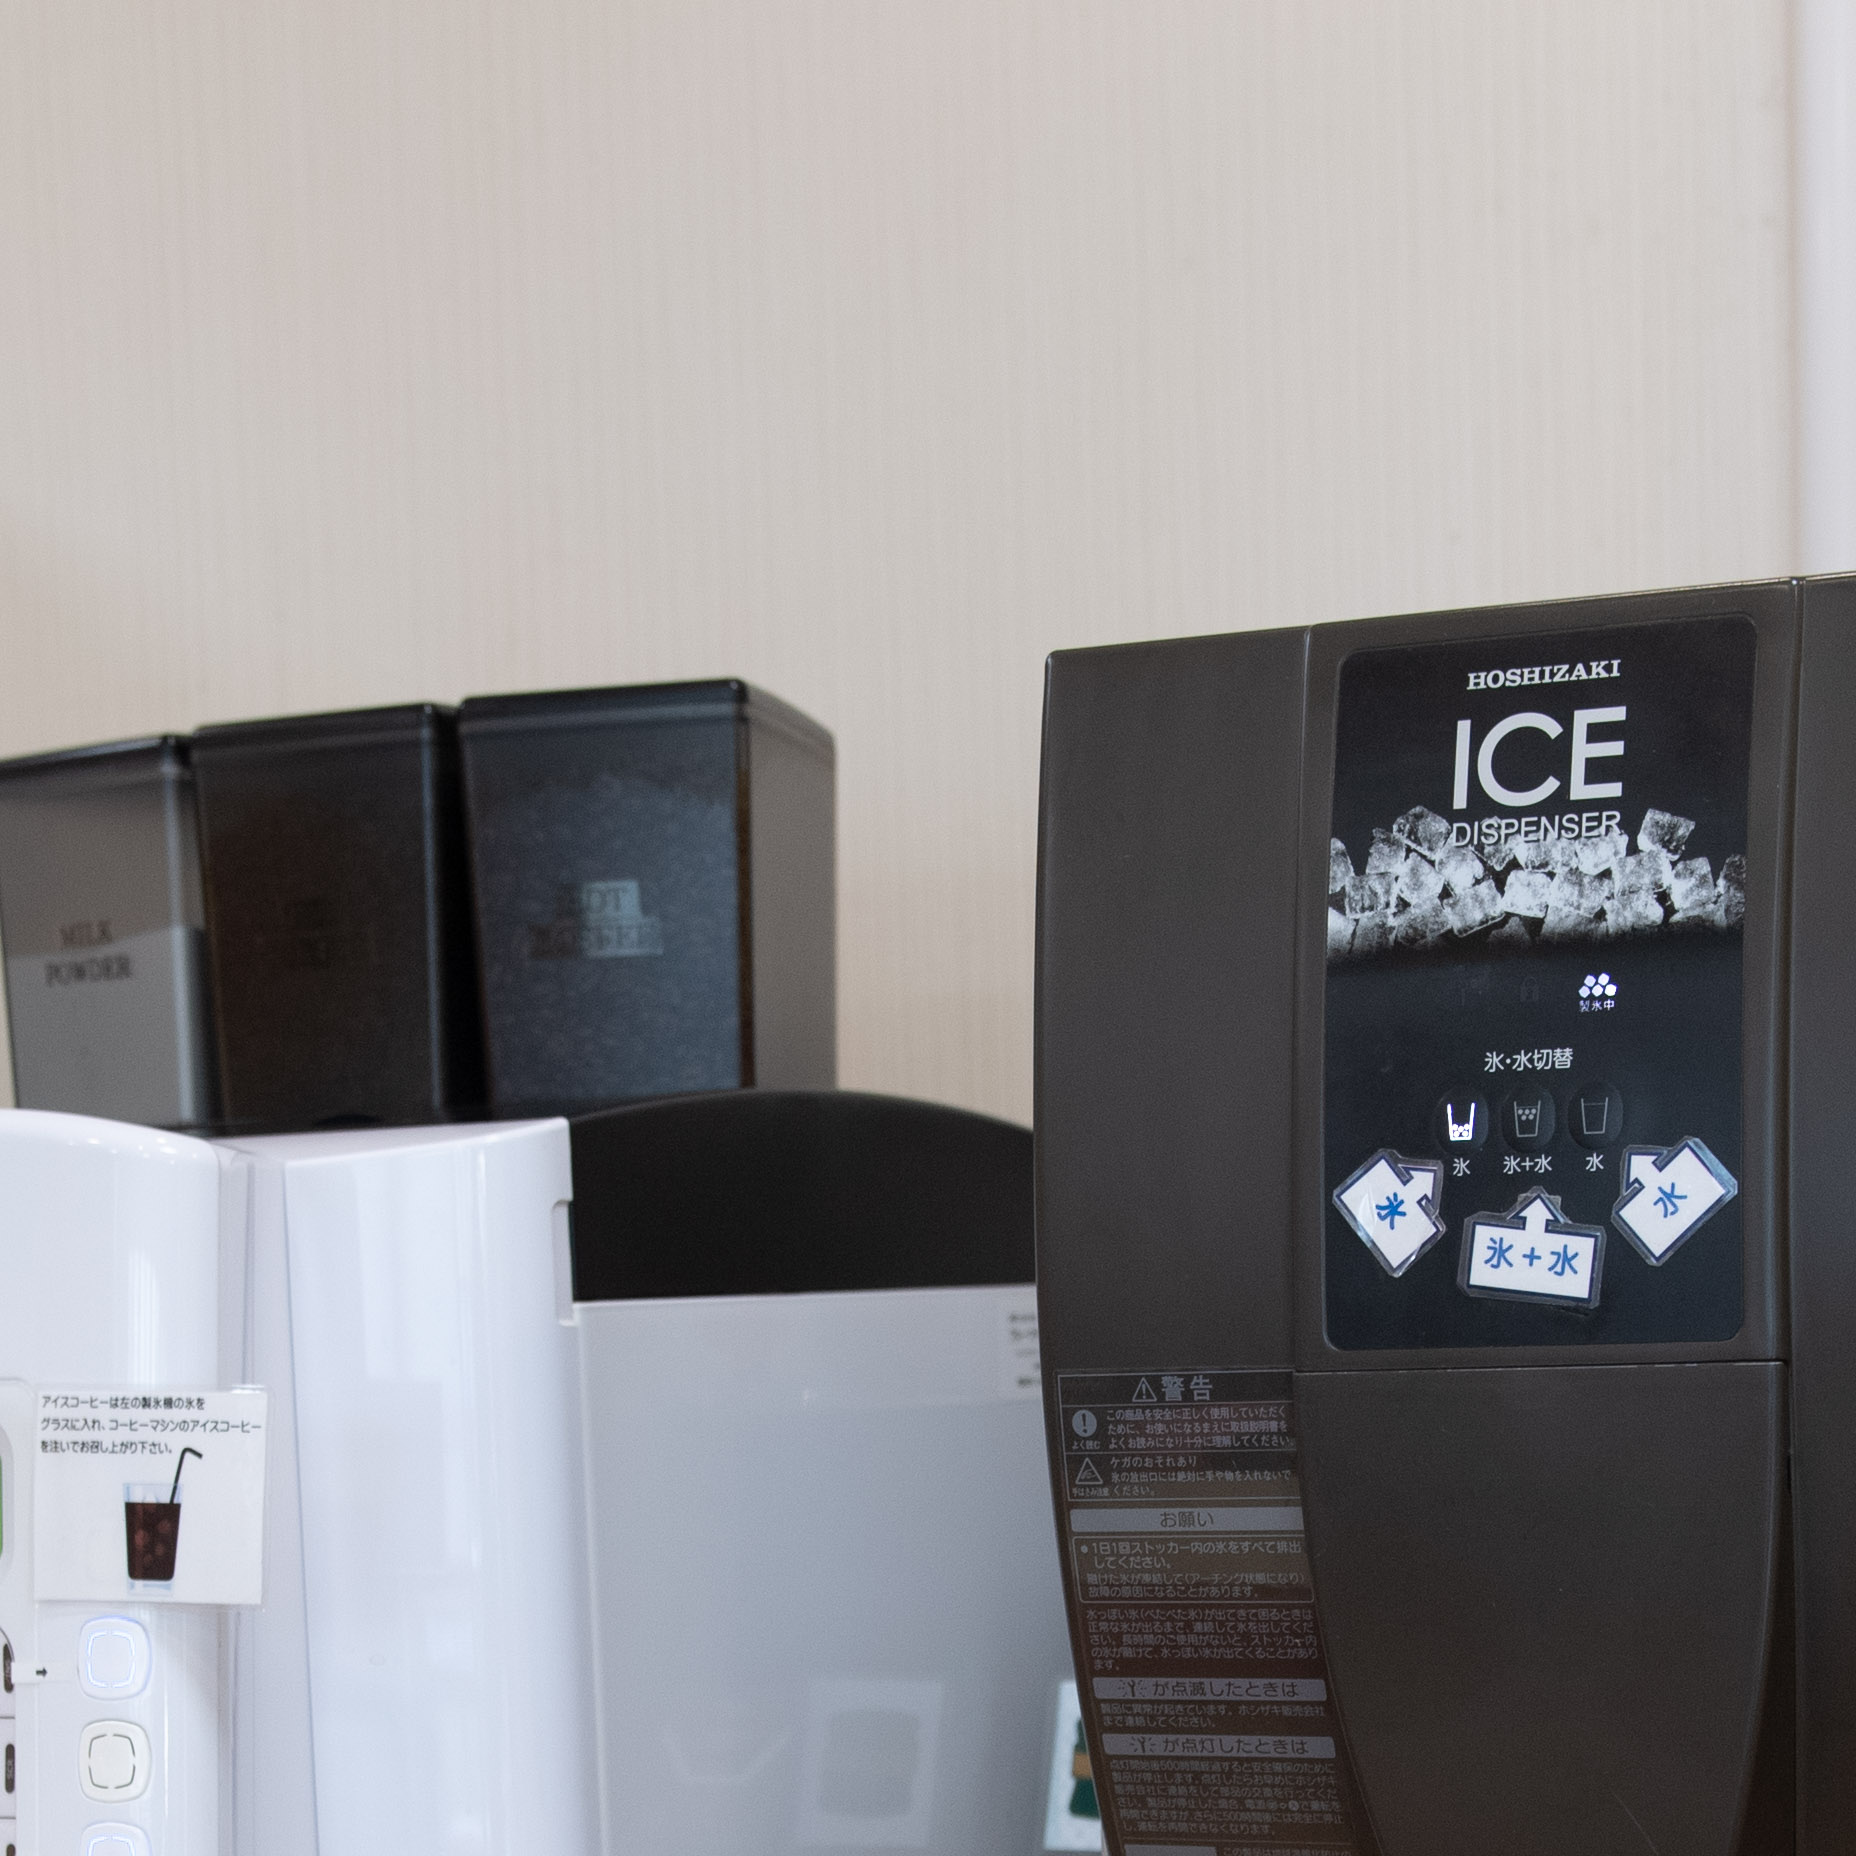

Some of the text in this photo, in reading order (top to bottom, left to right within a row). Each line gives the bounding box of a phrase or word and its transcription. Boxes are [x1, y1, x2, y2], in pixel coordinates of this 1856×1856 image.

[1466, 659, 1621, 690] HOSHIZAKI
[1452, 705, 1627, 810] ICE
[1453, 811, 1623, 847] DISPENSER
[59, 920, 113, 948] MILK
[45, 955, 133, 988] POWDER
[1579, 1000, 1616, 1013] 製氷中
[1452, 1157, 1471, 1177] 氷
[1585, 1152, 1605, 1172] 水
[1653, 1182, 1689, 1219] 水
[1375, 1191, 1407, 1231] 氷
[1161, 1375, 1213, 1401] 警告
[42, 1395, 205, 1411] アイスコーヒーは左の製氷機の氷を
[41, 1417, 262, 1434] グラスに入れ、コーヒーマシンのアイスコーヒー
[40, 1439, 173, 1455] を注いでお召し上がり下さい。
[1110, 1455, 1198, 1469] ケガのおそれあり
[1112, 1485, 1156, 1498] ください。
[1159, 1511, 1214, 1529] お願い
[1093, 1555, 1173, 1570] してください。
[1094, 1659, 1121, 1671] ます。
[1153, 1681, 1300, 1698] が点滅したときは
[1162, 1737, 1309, 1755] が点灯したときは
